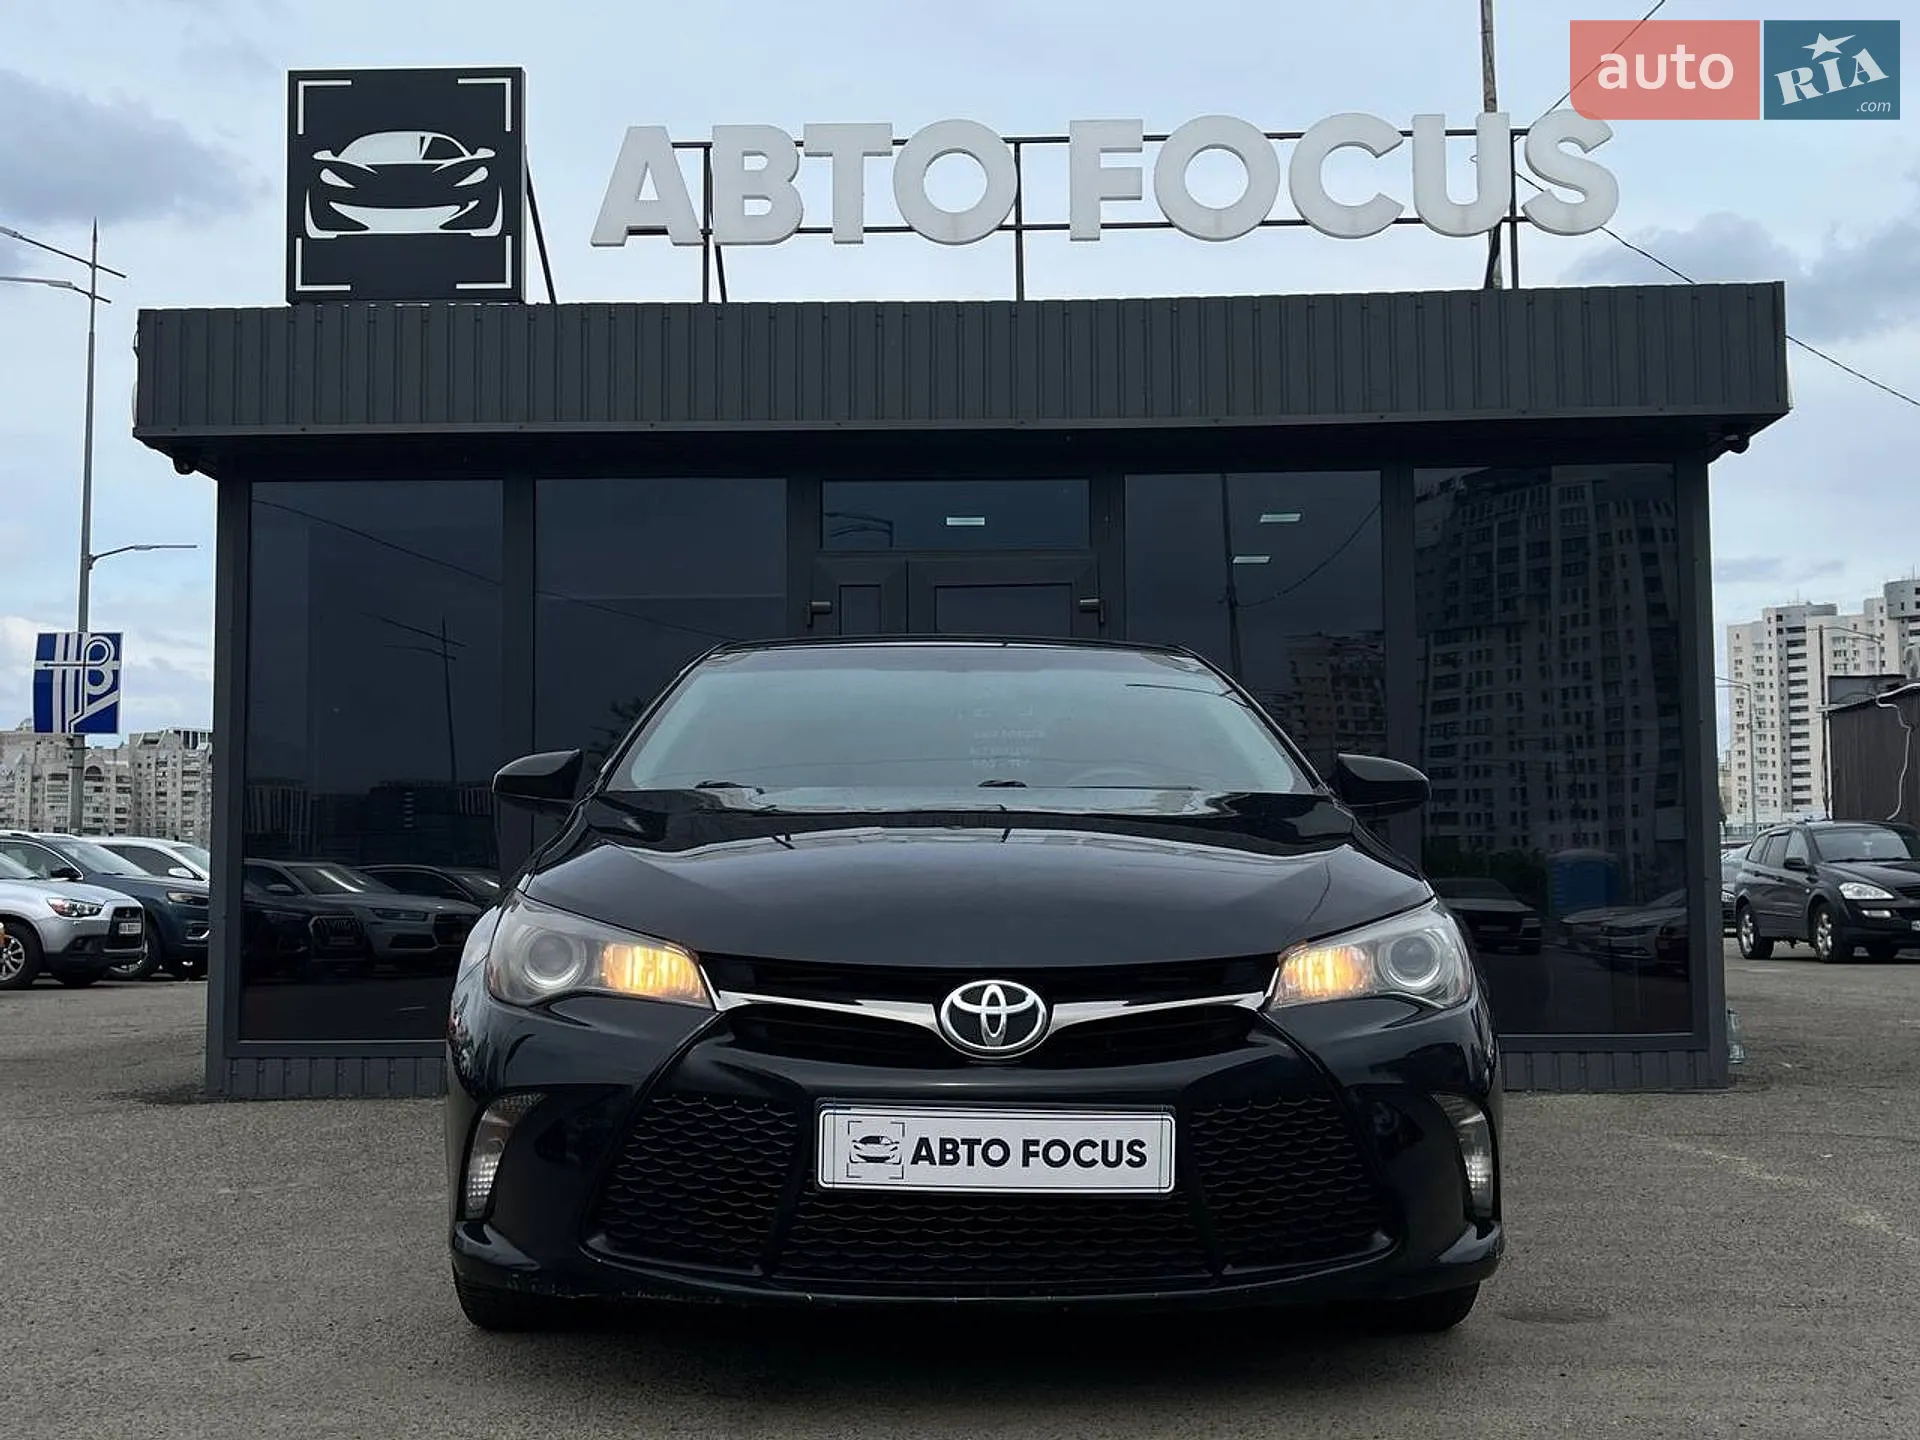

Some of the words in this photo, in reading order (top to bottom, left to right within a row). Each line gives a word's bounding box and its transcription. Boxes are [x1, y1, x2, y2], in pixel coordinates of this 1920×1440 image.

[590, 118, 1018, 247] АВТО
[1069, 110, 1619, 242] FOCUS
[911, 1137, 1011, 1168] АВТО
[1021, 1138, 1148, 1169] FOCUS
